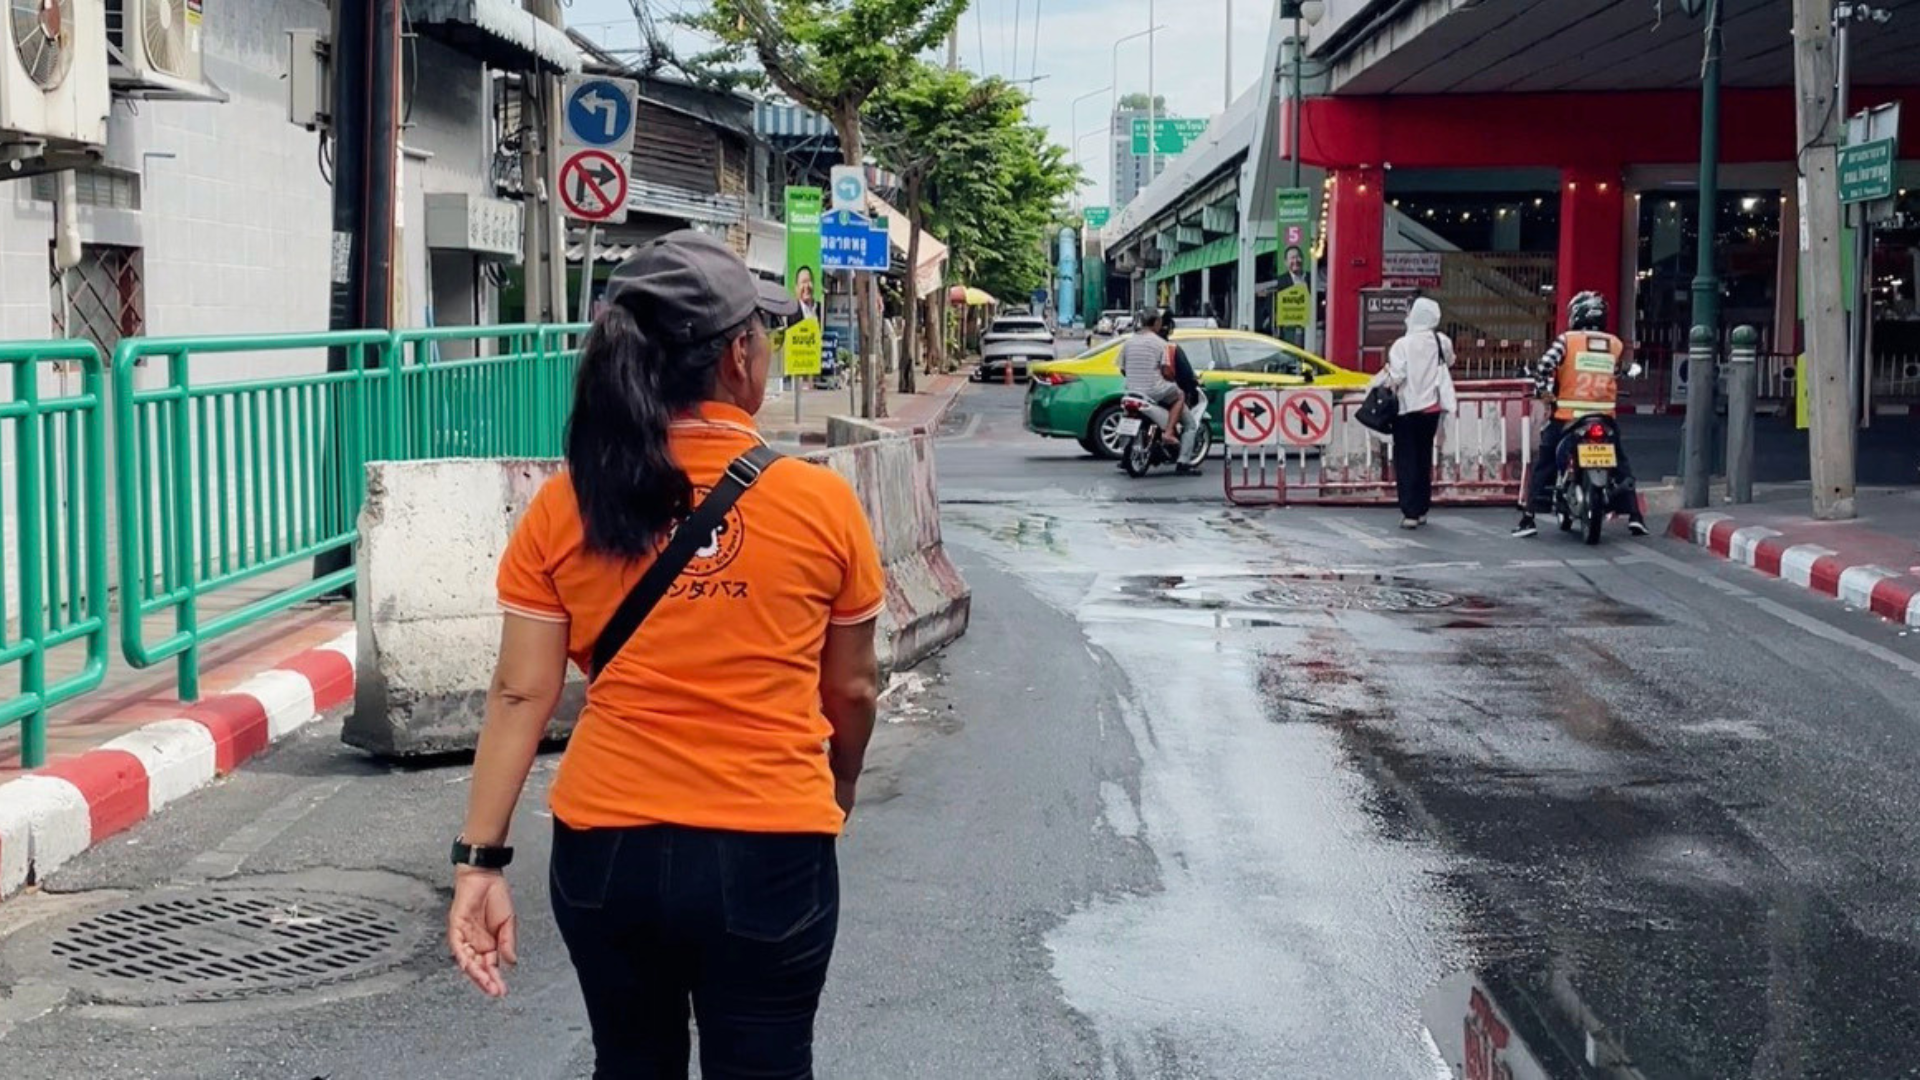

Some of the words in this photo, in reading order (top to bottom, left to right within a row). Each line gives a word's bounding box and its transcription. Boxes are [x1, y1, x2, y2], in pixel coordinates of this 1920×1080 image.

[1288, 226, 1300, 243] 5
[664, 580, 748, 600] ンダバス
